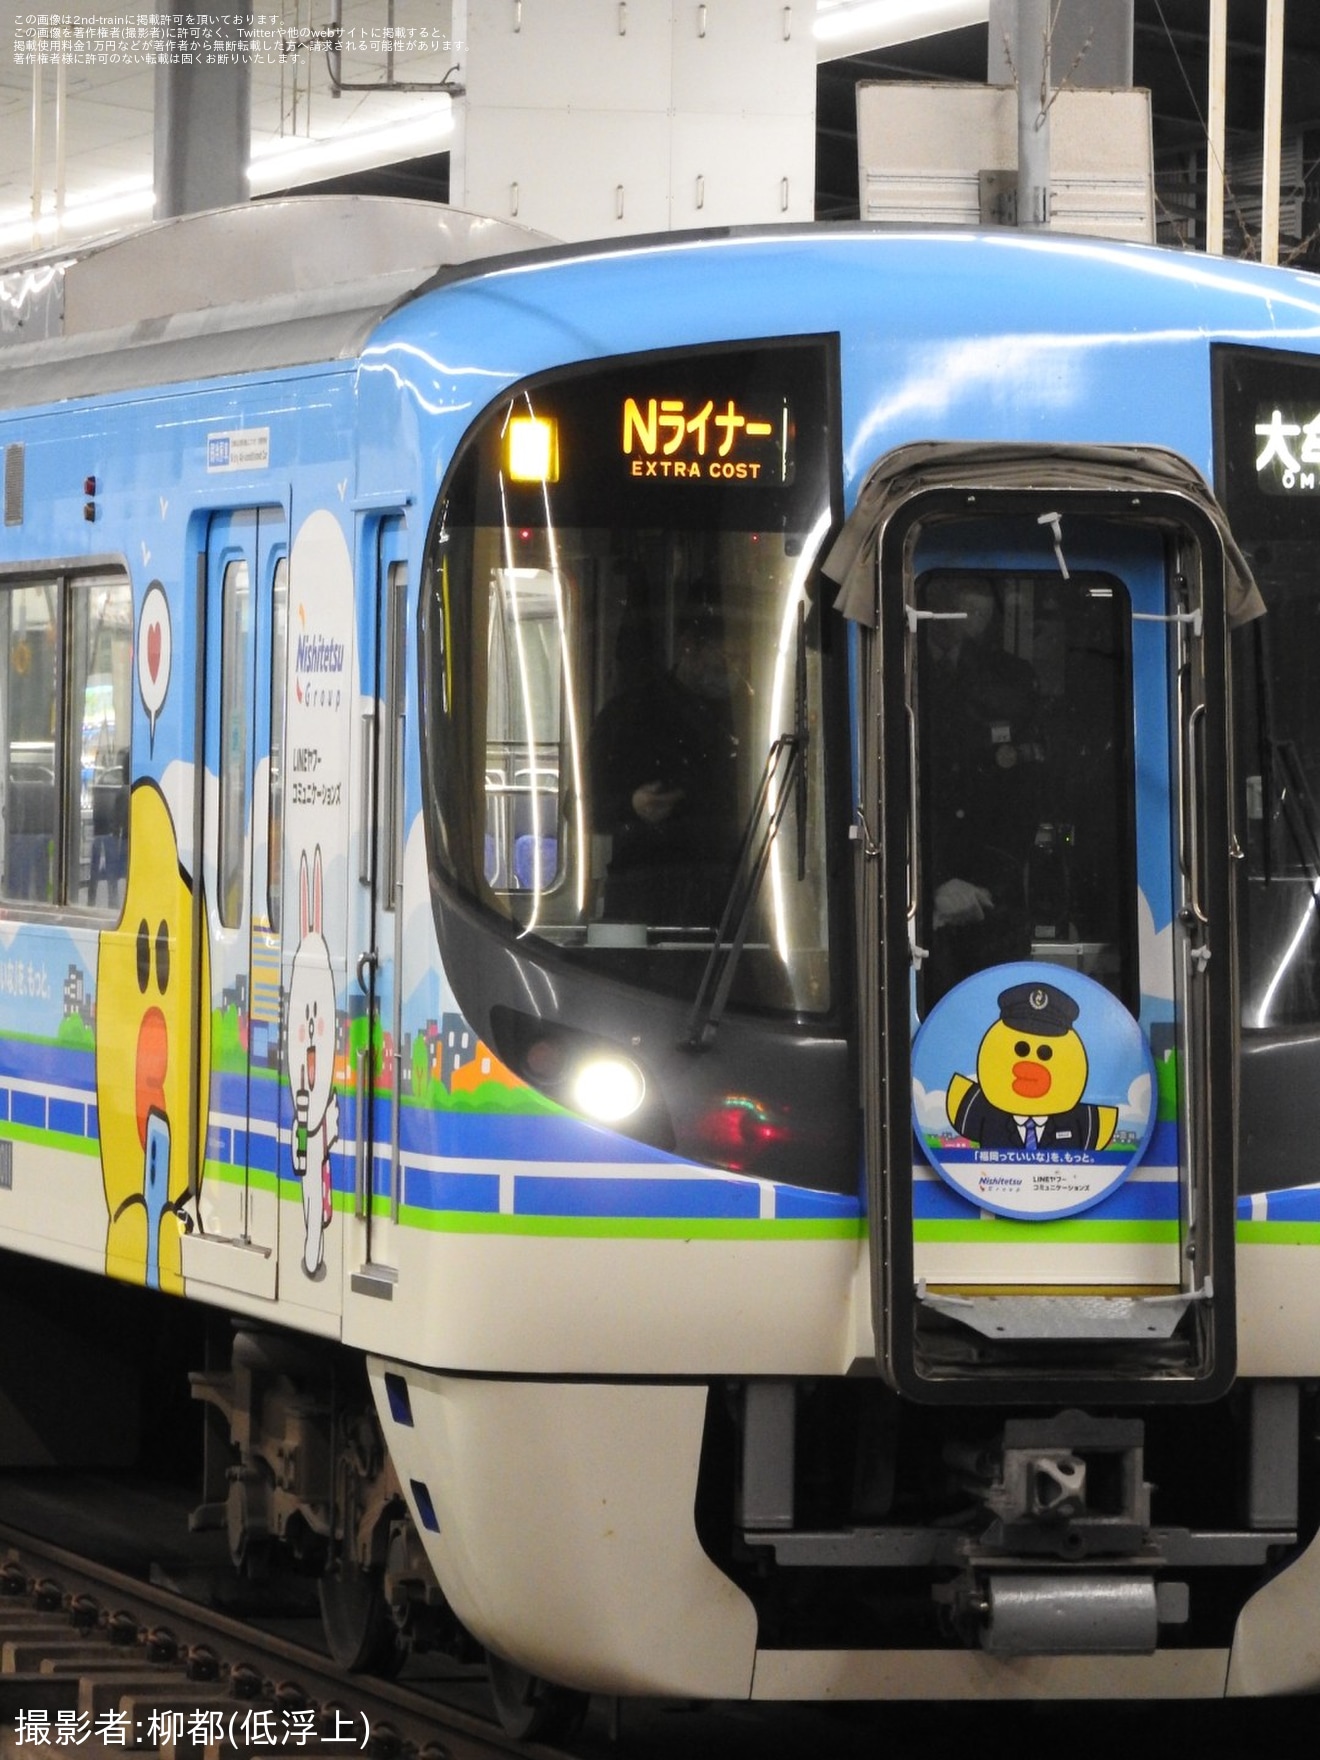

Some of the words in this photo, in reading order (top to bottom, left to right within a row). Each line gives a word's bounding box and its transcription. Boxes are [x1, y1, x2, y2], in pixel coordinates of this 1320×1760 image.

[623, 398, 772, 457] Nライナー
[631, 461, 701, 478] EXTRA
[709, 463, 761, 479] COST
[296, 634, 344, 673] Nishitetsu
[304, 682, 341, 713] Group
[293, 748, 321, 772] LINEヤフー
[979, 1176, 1022, 1186] Nishitetsu
[1033, 1175, 1067, 1184] LINEヤフー
